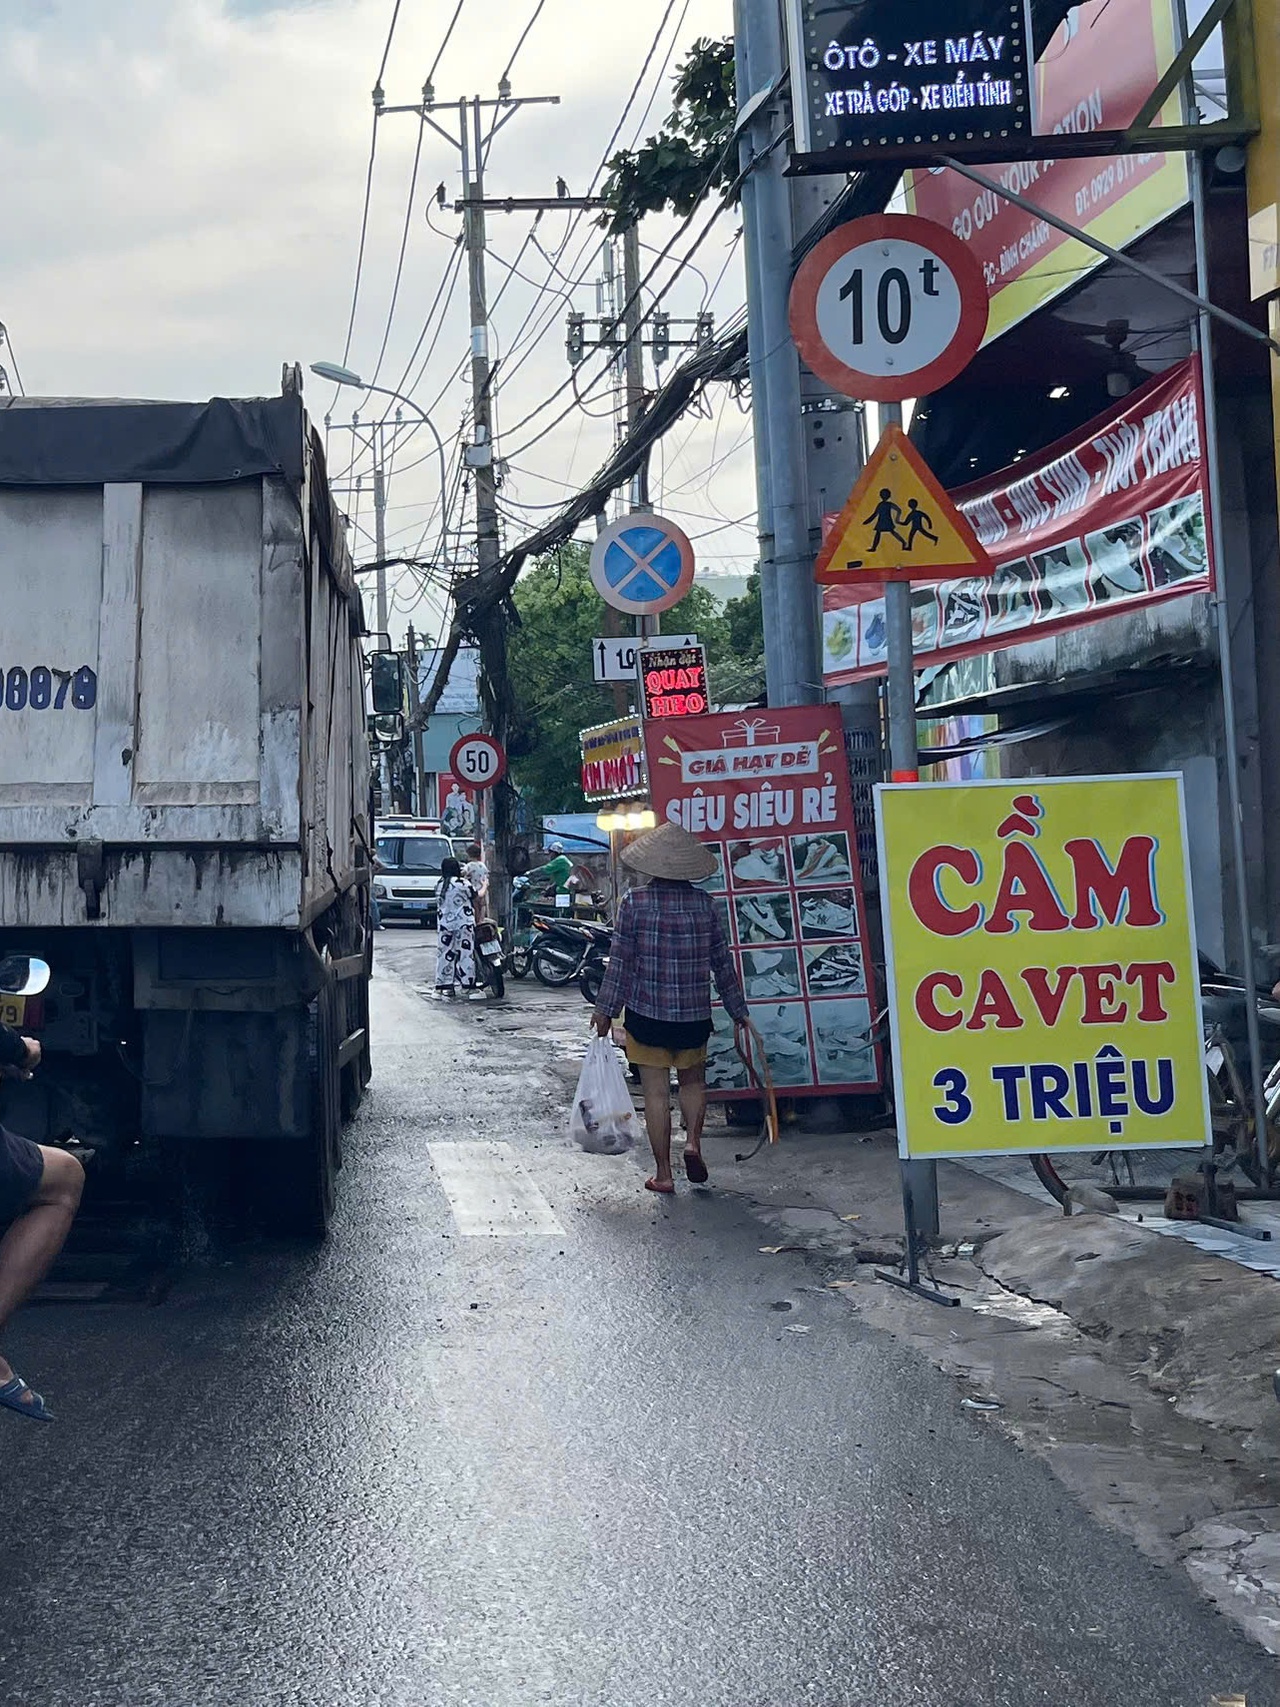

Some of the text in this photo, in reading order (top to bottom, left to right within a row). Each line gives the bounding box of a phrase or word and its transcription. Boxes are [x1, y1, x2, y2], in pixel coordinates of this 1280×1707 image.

[823, 37, 880, 70] ÔTÔ
[903, 40, 938, 67] XE
[944, 30, 1005, 64] MÁY
[824, 90, 844, 116] XE
[845, 80, 875, 115] TRẢ
[877, 81, 910, 112] GÓP
[920, 84, 940, 111] XE
[647, 667, 701, 695] QUAY
[650, 693, 704, 717] HEO
[466, 750, 489, 774] 50
[733, 753, 777, 774] HẠT
[666, 772, 837, 833] SIÊU SIÊU RẺ
[908, 794, 1166, 936] CẦM
[914, 962, 1176, 1032] CAVET
[933, 1044, 1174, 1134] 3 TRIỆU
